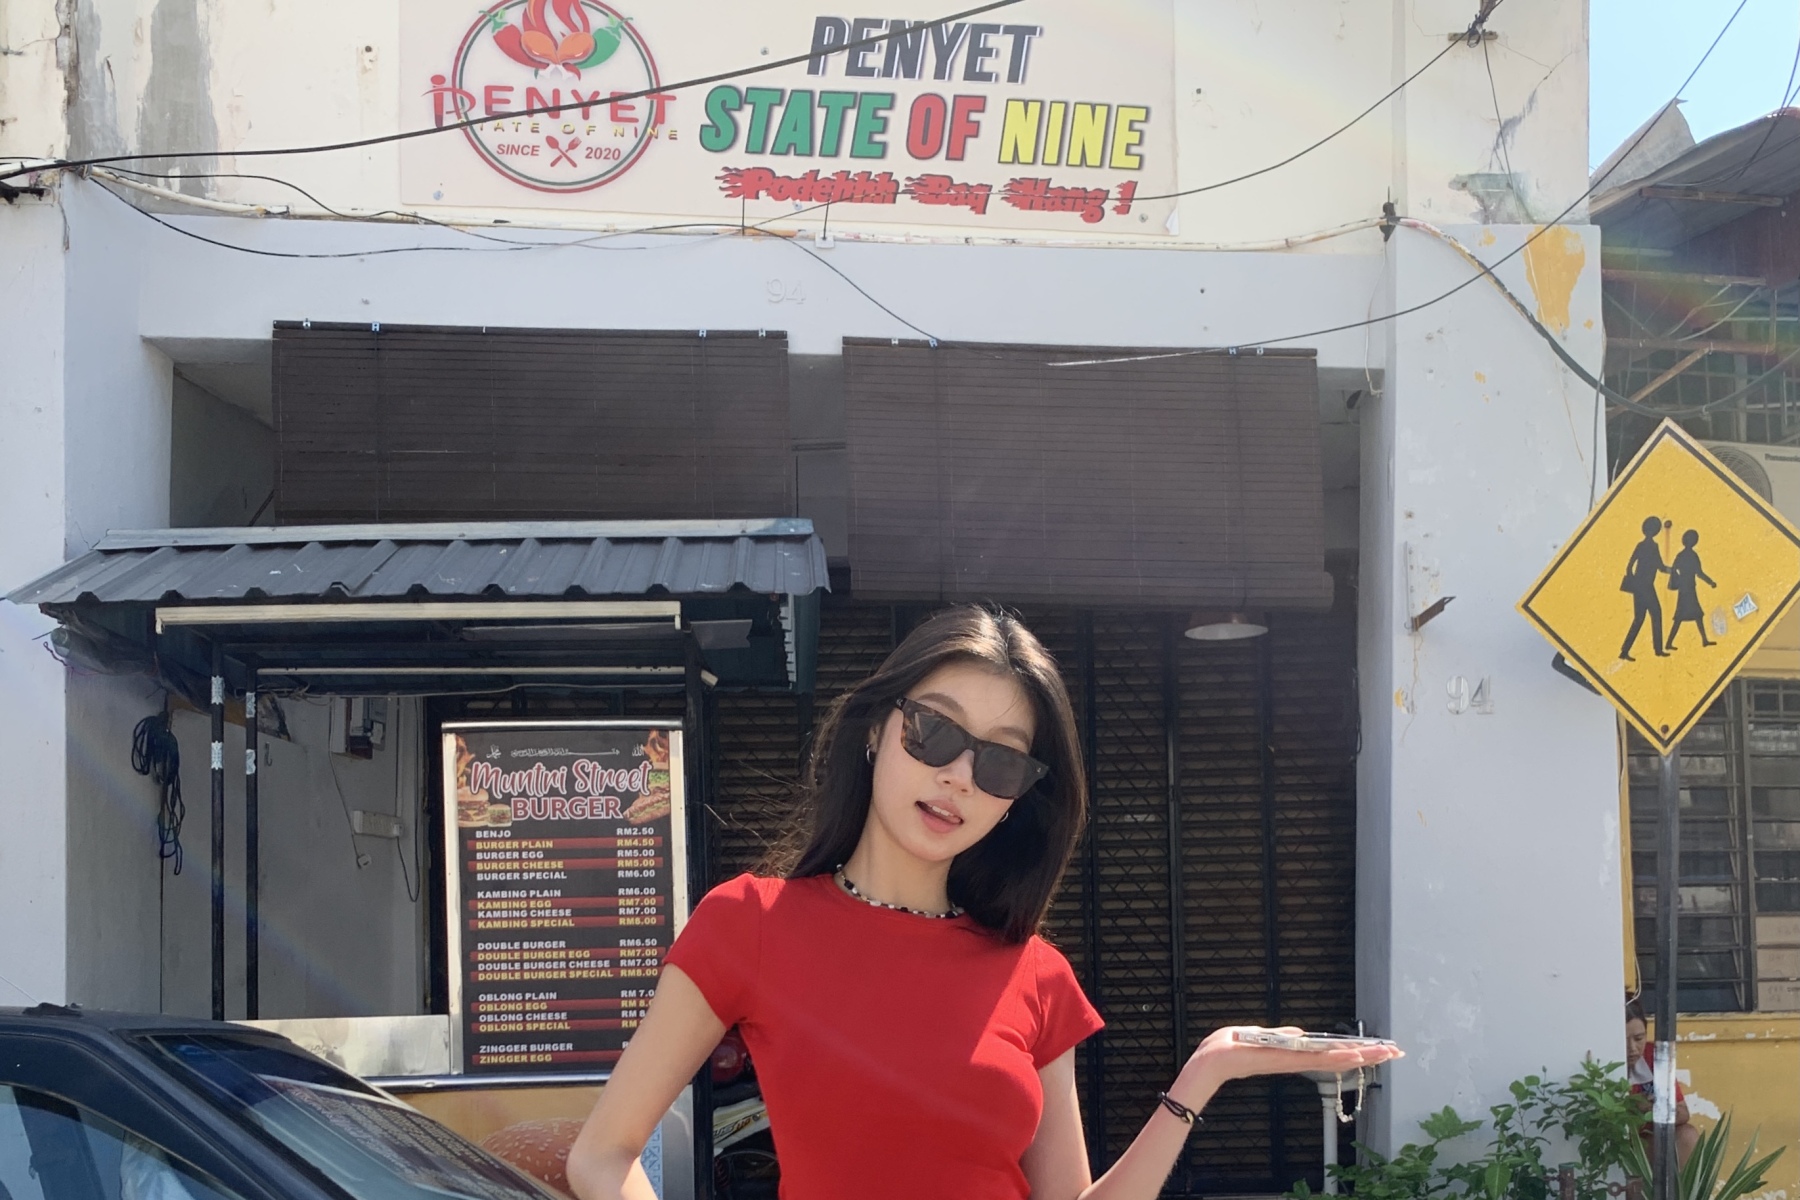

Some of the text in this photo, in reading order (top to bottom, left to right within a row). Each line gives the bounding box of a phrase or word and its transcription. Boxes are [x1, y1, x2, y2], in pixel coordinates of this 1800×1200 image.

[807, 16, 1041, 83] PENYET
[561, 122, 597, 138] OF
[613, 125, 679, 141] NINE
[699, 85, 1150, 170] STATE OF NINE
[496, 143, 621, 161] SINCE 2020
[1446, 675, 1495, 715] 94
[470, 759, 652, 799] Muntri Street
[511, 796, 624, 821] BURGER
[476, 830, 511, 838] BENJO
[616, 827, 654, 836] RM2.50
[476, 840, 553, 849] BURGER PLAIN
[617, 839, 654, 847] RM4.50
[476, 851, 544, 860] BURGER EGG
[617, 849, 654, 857] RM5.00
[476, 861, 564, 870] BURGER CHEESE
[617, 859, 655, 867] RM5.00
[476, 871, 567, 881] BURGER SPECIAL
[617, 870, 655, 878] RM6.00
[477, 889, 561, 899] KAMBING PLAIN
[618, 888, 656, 896] RM6.00
[477, 900, 552, 910] KAMBING EGG
[618, 898, 656, 906] RM7.00
[477, 908, 572, 919] KAMBING CHEESE
[618, 907, 656, 915] RM7.00
[477, 919, 575, 929] KAMBING SPECIAL
[477, 941, 566, 951] DOUBLE BURGER
[619, 938, 657, 947] RM6.50
[477, 951, 590, 961] DOUBLE BURGER EGG
[619, 949, 658, 957] RM7.00
[478, 960, 610, 971] DOUBLE BURGER CHEESE
[620, 958, 658, 967] RM7.00
[478, 970, 614, 981] DOUBLE BURGER SPECIAL
[620, 969, 658, 977] RM8.00
[478, 992, 557, 1002] OBLONG PLAIN
[620, 989, 655, 998] RM 7.0
[479, 1002, 548, 1012] OBLONG EGG
[621, 1000, 636, 1008] RM
[479, 1012, 568, 1022] OBLONG CHEESE
[621, 1010, 637, 1018] RM
[479, 1023, 571, 1032] OBLONG SPECIAL
[621, 1020, 637, 1028] RM
[479, 1043, 573, 1053] ZINGGER BURGER
[480, 1054, 552, 1064] ZINGGER EGG
